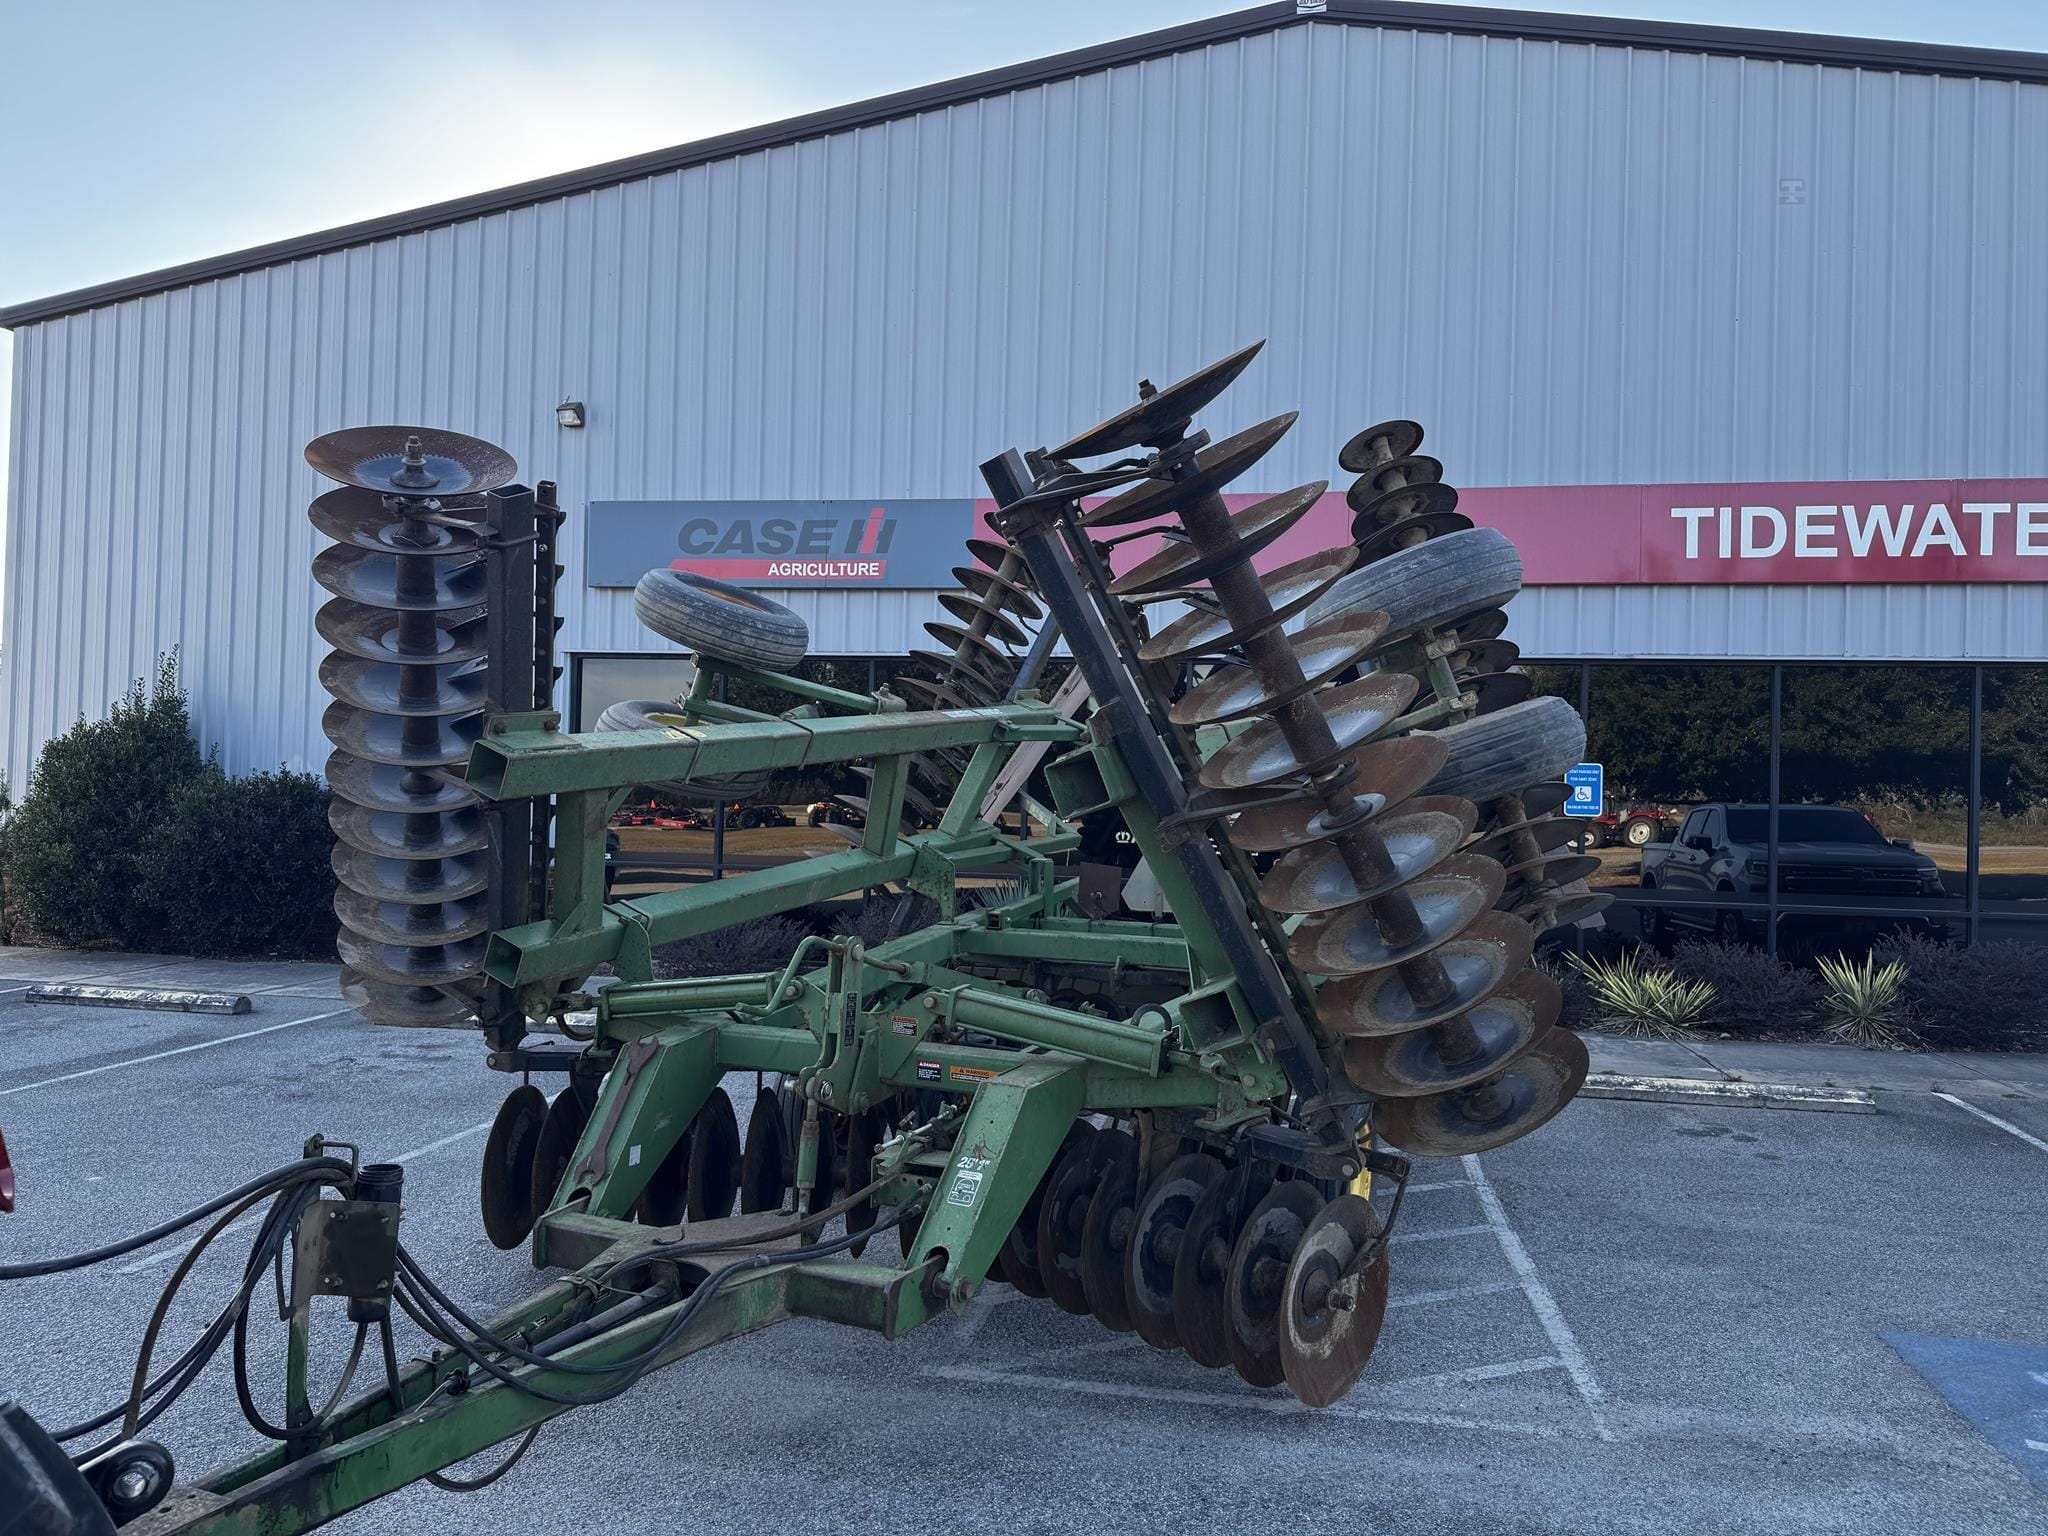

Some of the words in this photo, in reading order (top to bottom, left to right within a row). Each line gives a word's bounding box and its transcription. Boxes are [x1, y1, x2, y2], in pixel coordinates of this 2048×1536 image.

[677, 518, 839, 555] CASE
[1670, 503, 2048, 559] TIDEWATE
[767, 561, 880, 577] AGRICULTURE
[964, 1068, 990, 1077] WARNING
